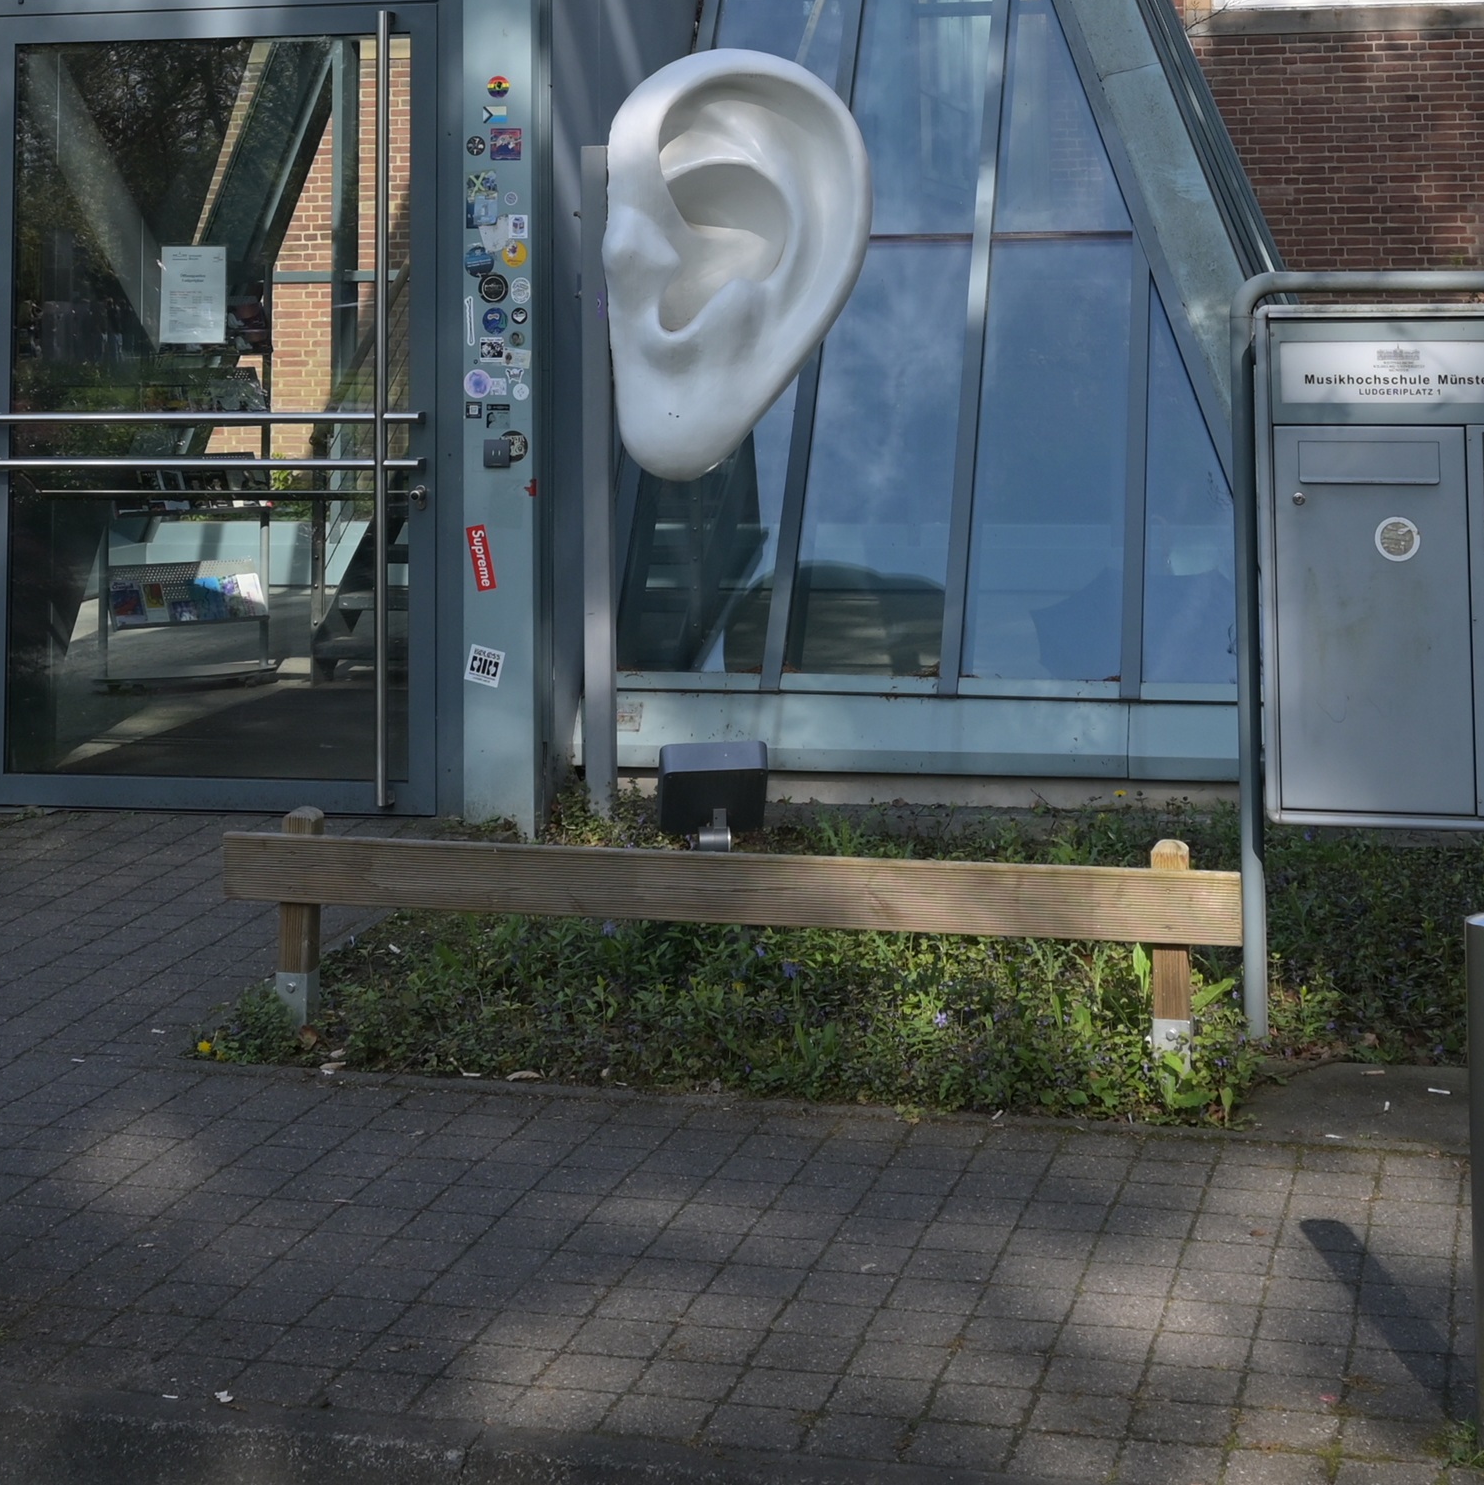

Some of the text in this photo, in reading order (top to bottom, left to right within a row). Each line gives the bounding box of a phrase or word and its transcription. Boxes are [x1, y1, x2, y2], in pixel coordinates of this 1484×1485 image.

[1304, 373, 1431, 386] Musikhochschule
[1358, 388, 1441, 396] LUDGERIPLATZ 1
[470, 529, 491, 587] Supreme
